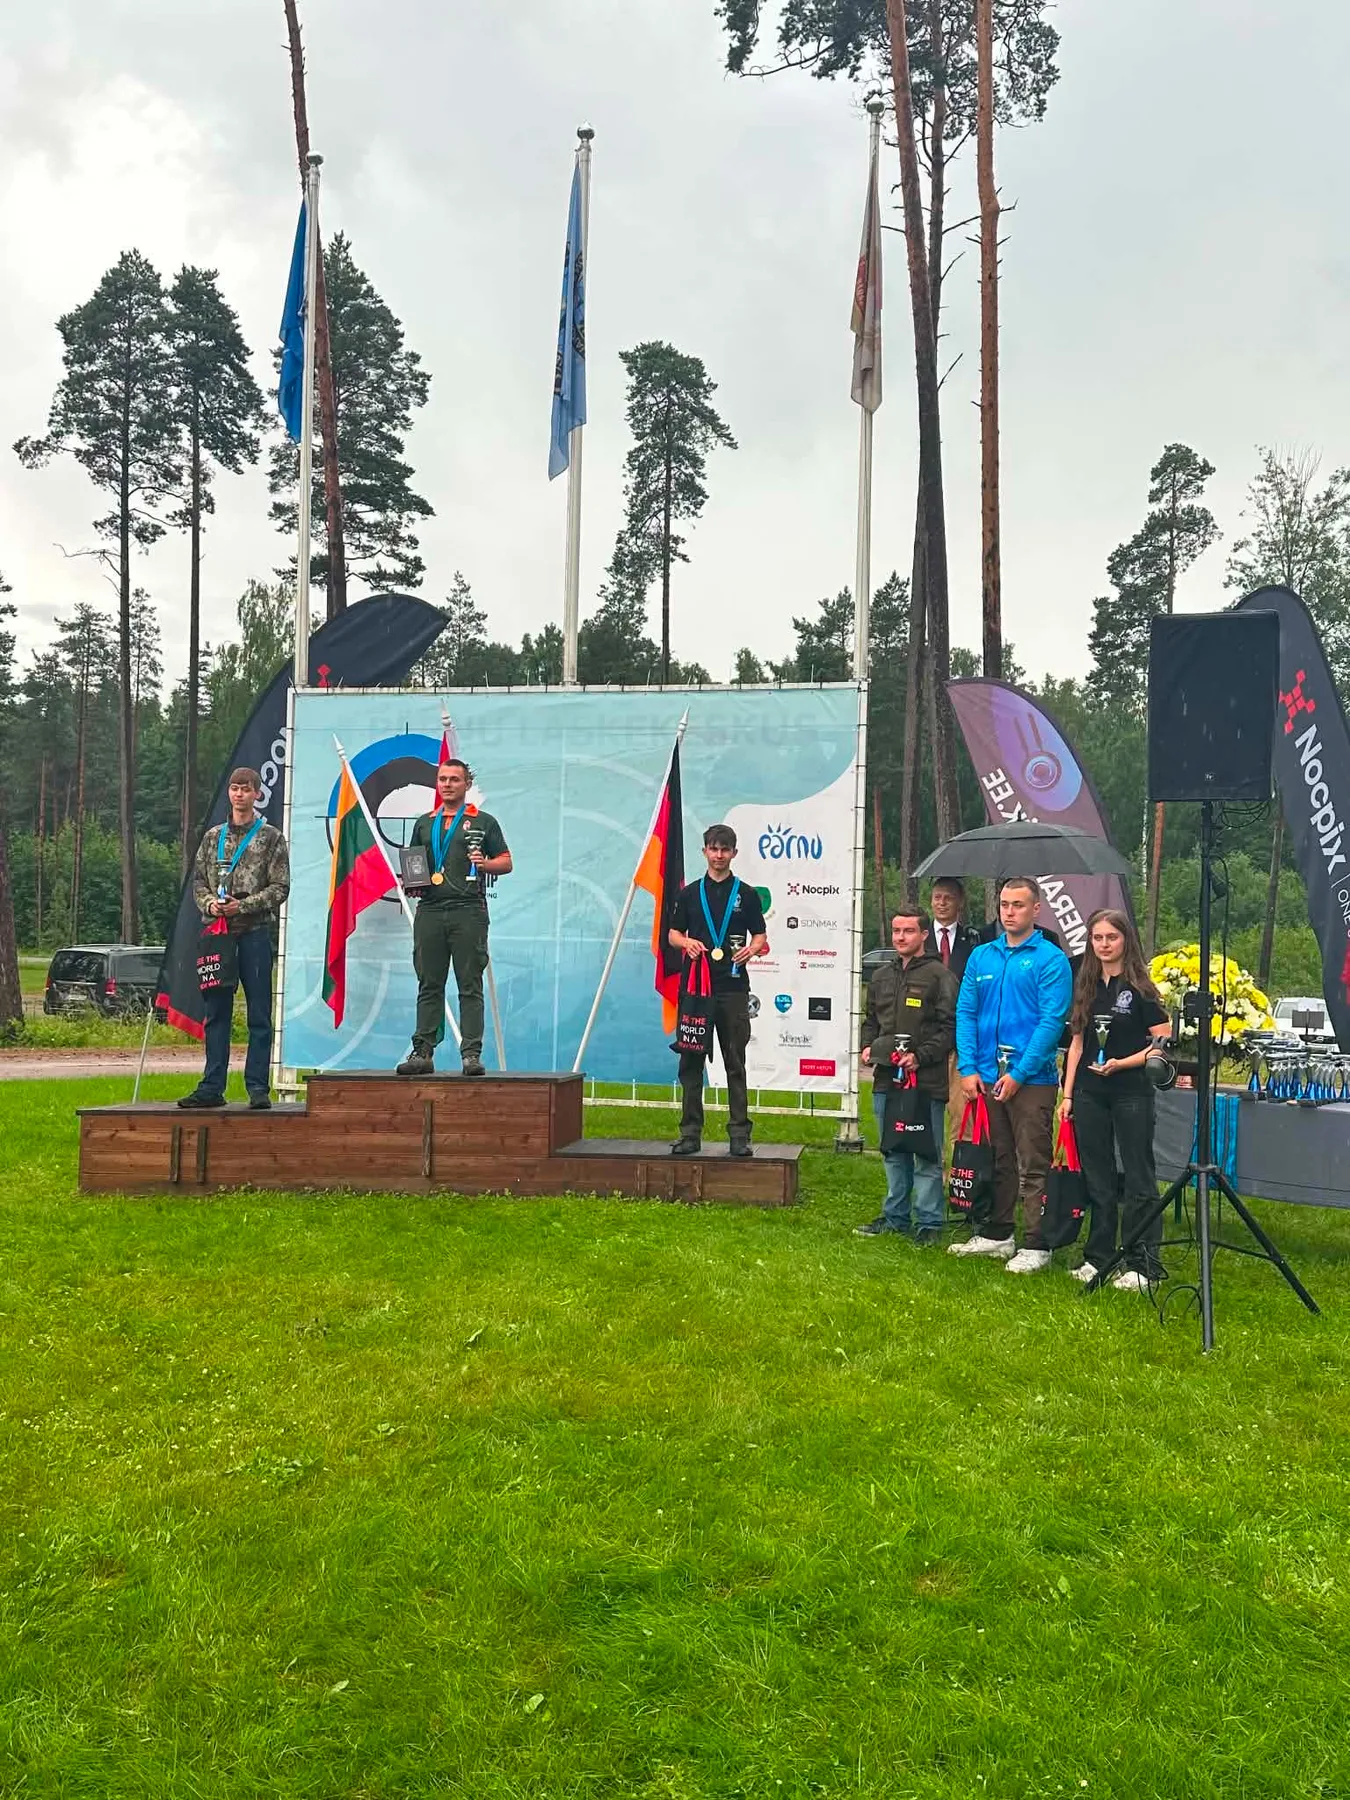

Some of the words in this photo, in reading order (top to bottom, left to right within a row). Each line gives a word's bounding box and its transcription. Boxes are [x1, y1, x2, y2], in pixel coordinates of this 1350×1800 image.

[1295, 724, 1346, 876] Nocpix
[802, 885, 839, 896] Nocpix
[206, 954, 221, 963] THE
[209, 972, 215, 981] A
[691, 1017, 706, 1026] THE
[681, 1023, 706, 1035] WORLD
[691, 1036, 698, 1044] A
[958, 1168, 975, 1179] THE
[960, 1190, 967, 1199] A
